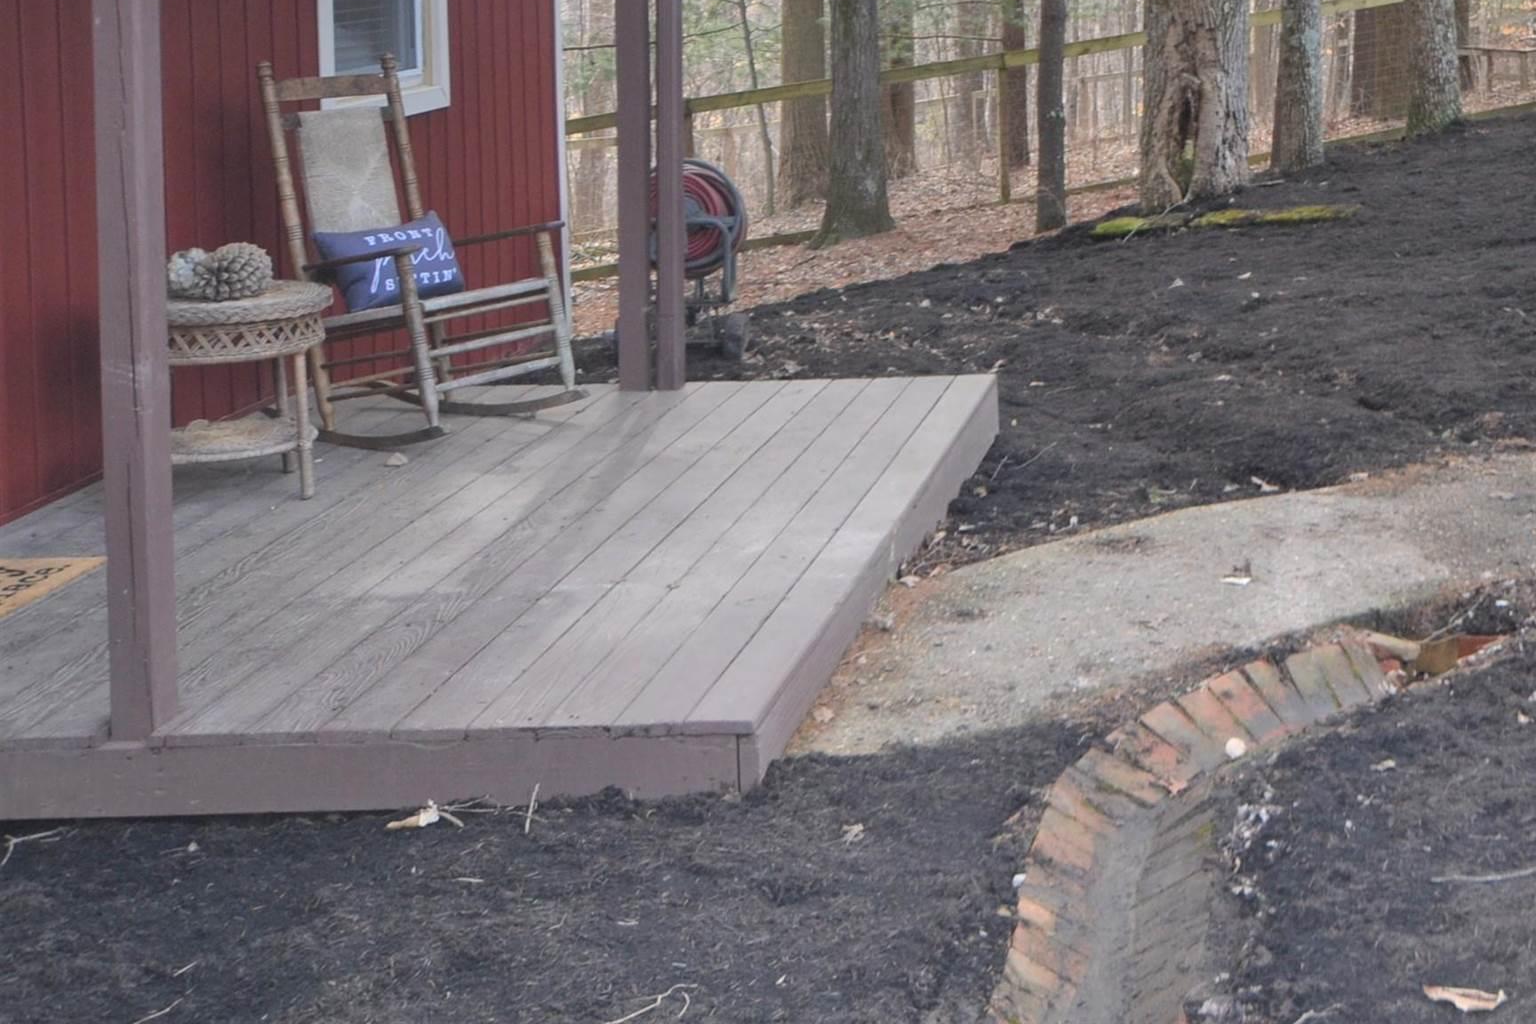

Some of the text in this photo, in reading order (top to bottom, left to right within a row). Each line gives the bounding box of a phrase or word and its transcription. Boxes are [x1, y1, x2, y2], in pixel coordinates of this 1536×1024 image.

[363, 227, 434, 247] FRONT
[370, 227, 456, 294] pch
[385, 267, 457, 291] STIN'
